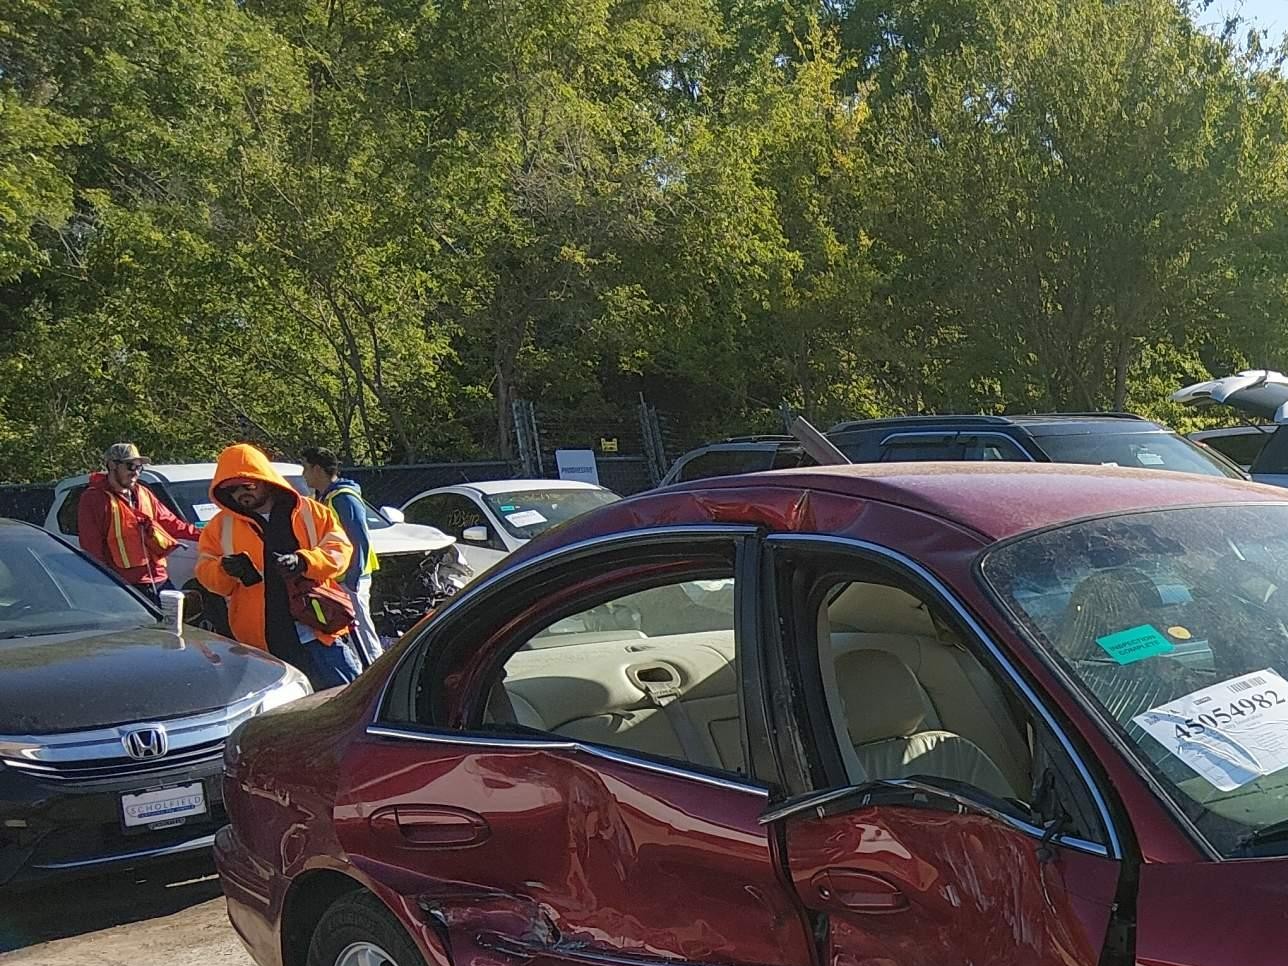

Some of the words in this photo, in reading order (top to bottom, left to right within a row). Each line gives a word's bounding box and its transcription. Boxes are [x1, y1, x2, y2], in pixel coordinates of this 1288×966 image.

[1109, 634, 1158, 652] INSPECTION
[1118, 640, 1161, 656] COMPLETE
[1174, 690, 1286, 739] 45054982
[129, 796, 202, 815] SCHOLFIELD
